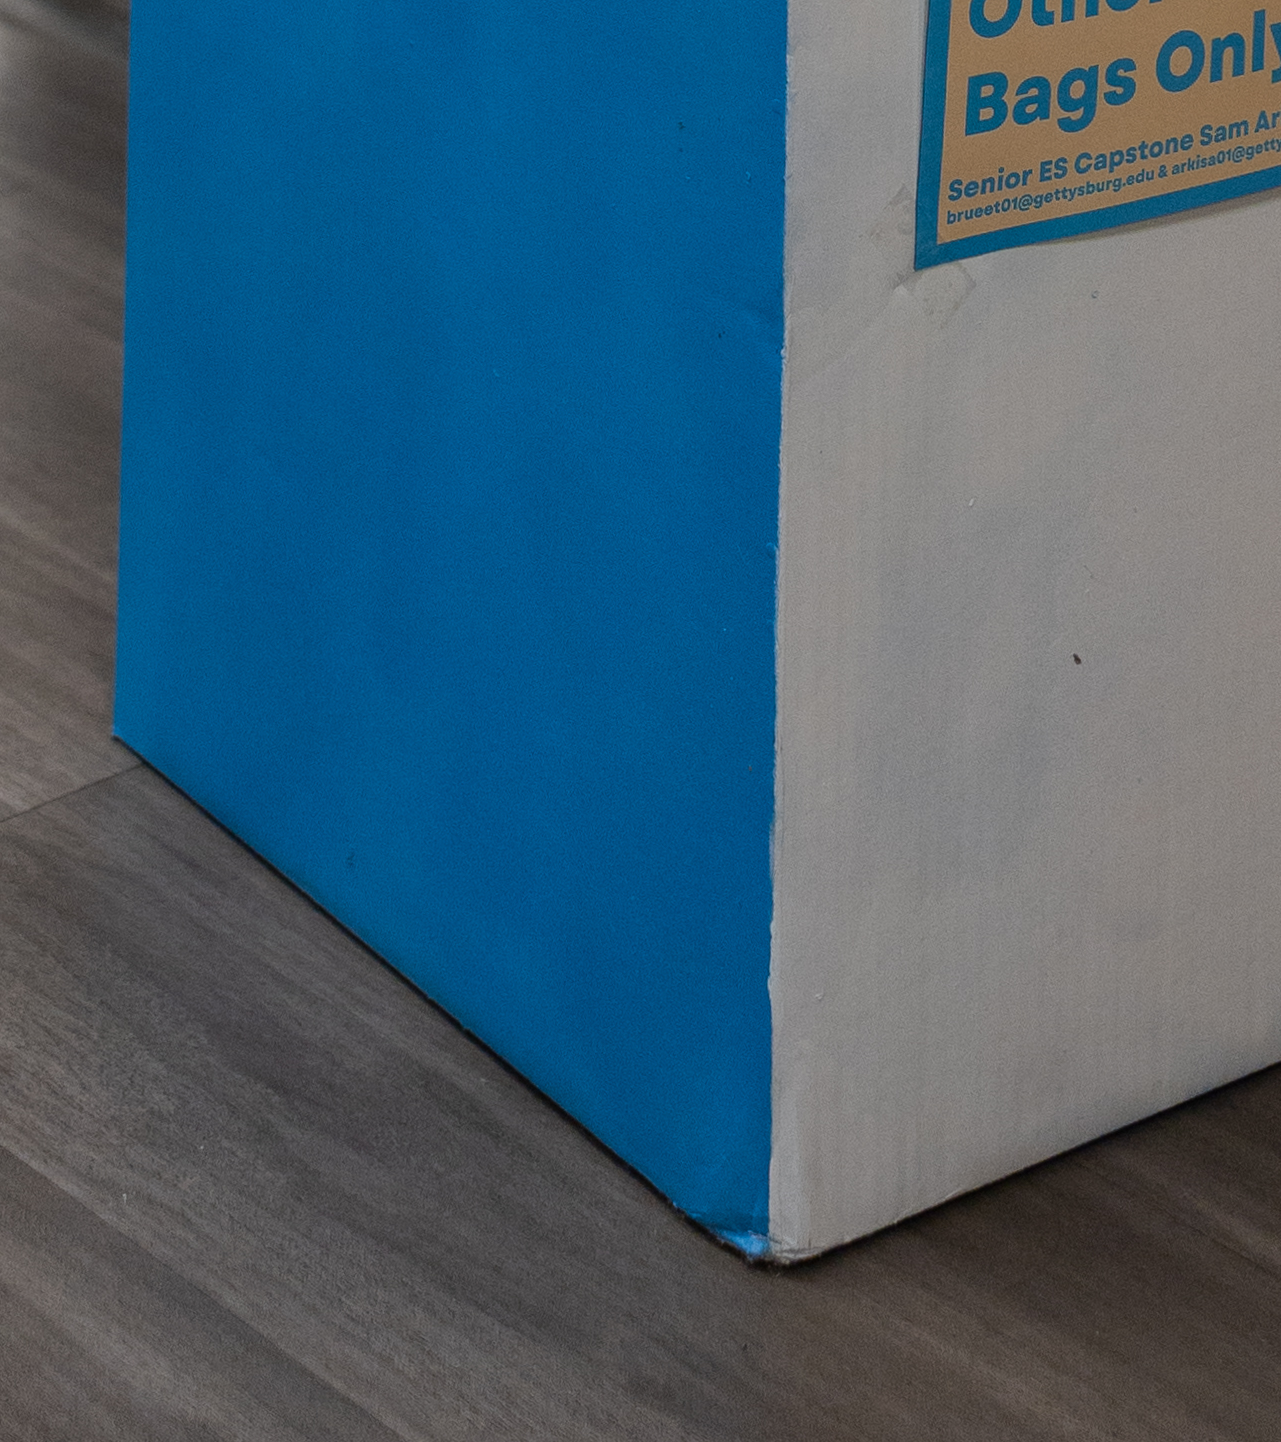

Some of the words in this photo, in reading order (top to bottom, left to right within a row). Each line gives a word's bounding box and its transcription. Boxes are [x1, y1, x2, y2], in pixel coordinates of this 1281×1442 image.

[965, 54, 1137, 135] Bags
[947, 167, 1154, 224] brueet01@gettysburg.edu
[1158, 165, 1168, 178] &
[948, 167, 1032, 201] Senior
[1039, 157, 1068, 182] ES
[1074, 133, 1194, 174] Capstone
[1200, 120, 1248, 146] Sam
